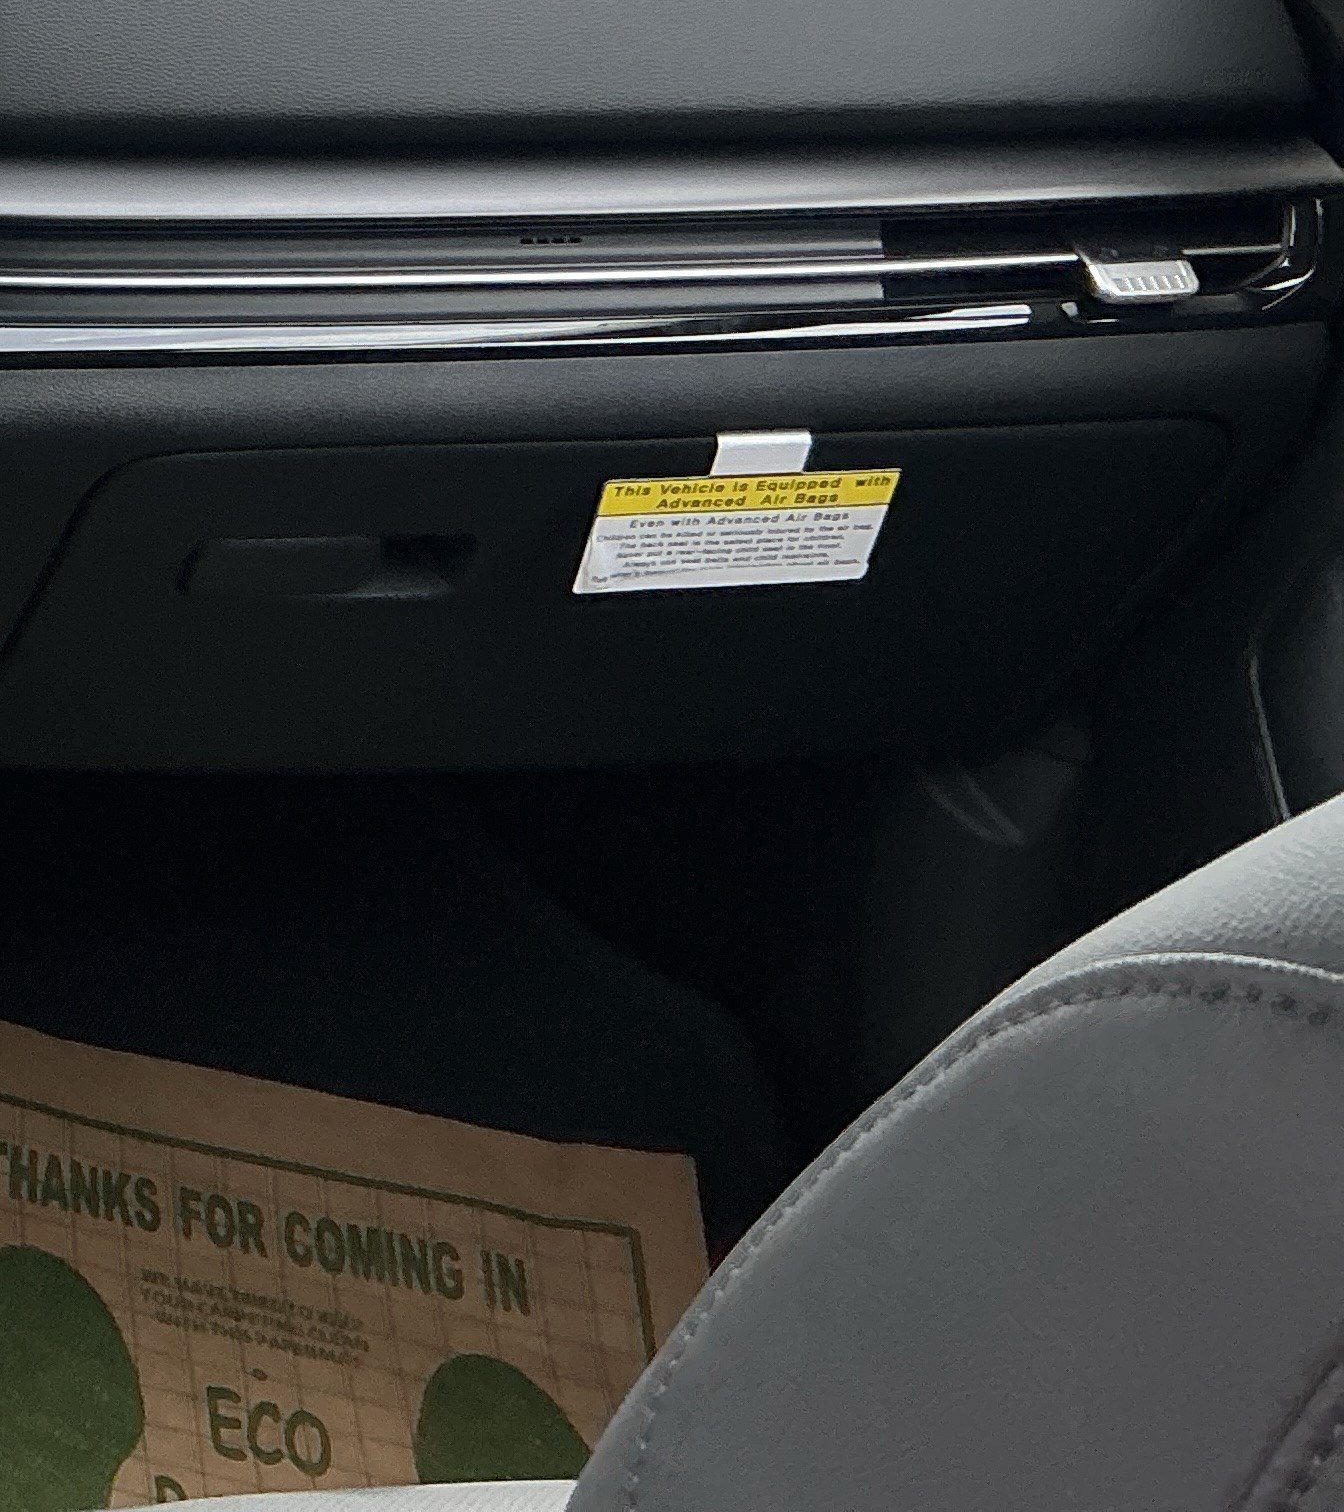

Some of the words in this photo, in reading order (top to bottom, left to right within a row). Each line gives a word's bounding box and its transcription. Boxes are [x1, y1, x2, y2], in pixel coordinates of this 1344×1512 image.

[614, 485, 651, 497] This
[661, 482, 725, 496] Vehicle
[732, 480, 749, 492] is
[755, 477, 842, 493] Equipped
[855, 475, 891, 488] with
[656, 495, 746, 509] Advanced
[761, 493, 786, 505] Air
[794, 492, 839, 505] Bags
[629, 518, 664, 529] Even
[671, 516, 700, 527] with
[707, 514, 780, 526] Advanced
[785, 512, 808, 523] Air
[814, 511, 850, 523] Bags
[179, 1188, 266, 1257] FOR
[284, 1209, 462, 1300] COMING
[479, 1249, 530, 1316] IN
[206, 1385, 332, 1477] ECO
